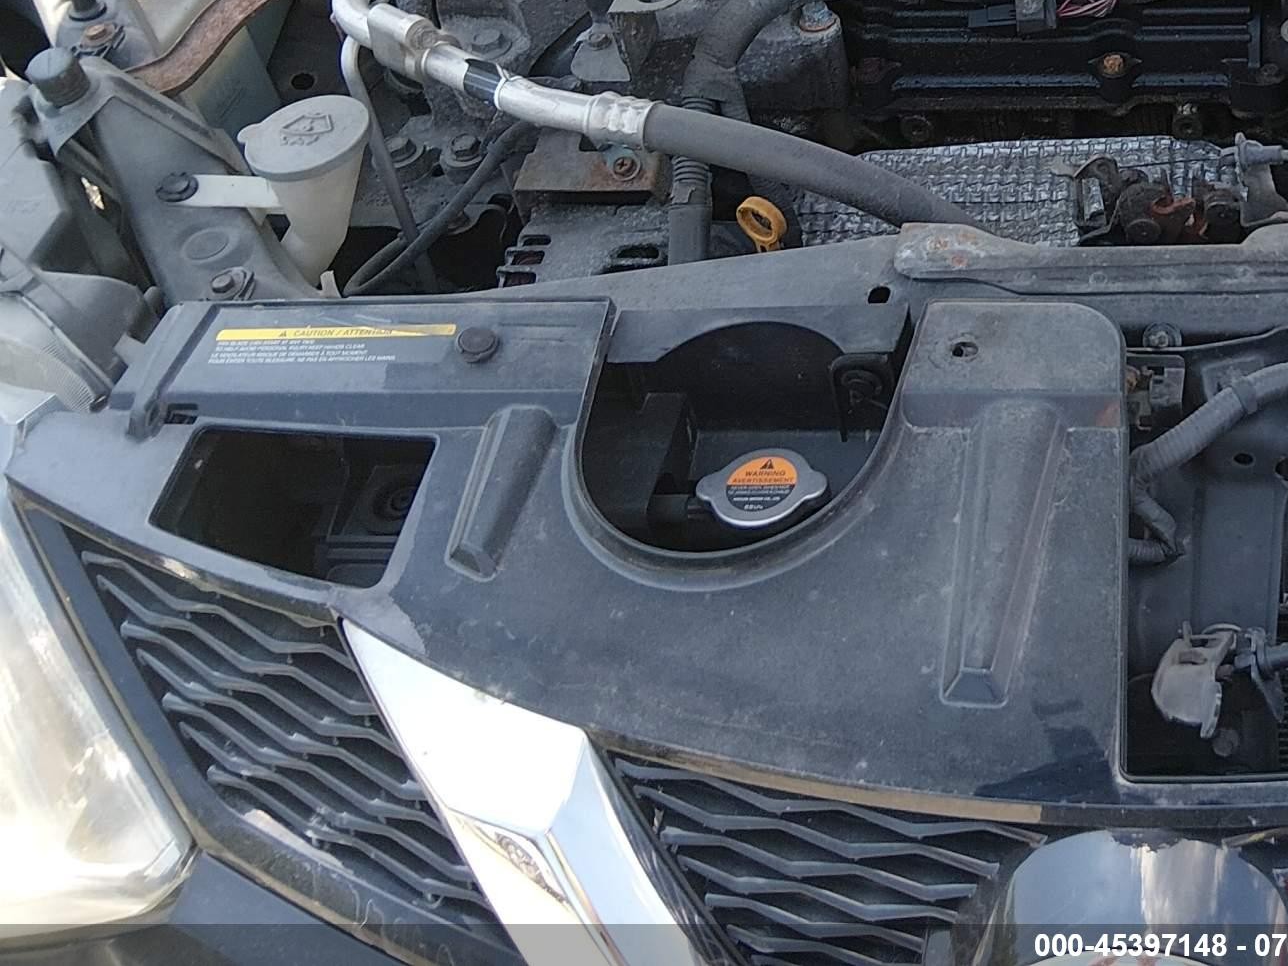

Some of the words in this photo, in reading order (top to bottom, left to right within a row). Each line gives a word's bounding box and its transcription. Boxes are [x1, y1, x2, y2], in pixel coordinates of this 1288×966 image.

[294, 329, 333, 337] CAUTION
[745, 469, 786, 477] WARNING
[732, 476, 795, 484] AVERTISSEMENT
